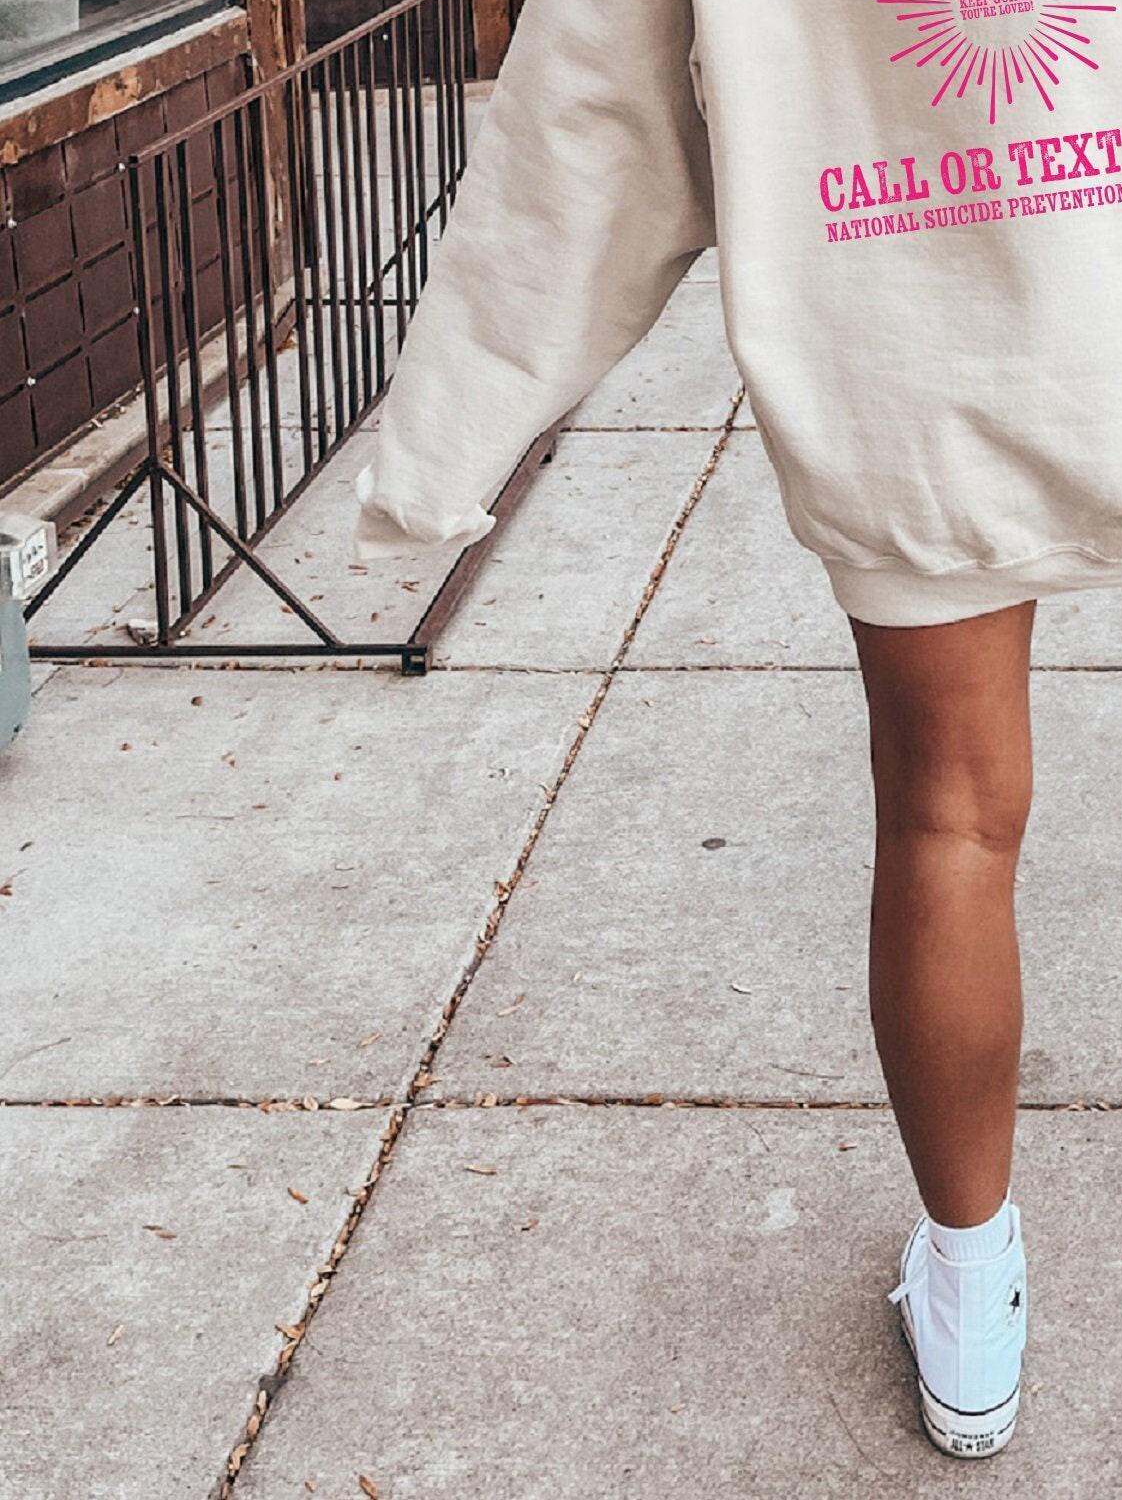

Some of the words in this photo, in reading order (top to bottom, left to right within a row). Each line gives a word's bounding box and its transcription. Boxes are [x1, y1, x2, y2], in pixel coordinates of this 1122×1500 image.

[960, 6, 997, 21] YOU'RE
[999, 0, 1034, 16] LOVED!
[819, 157, 930, 212] CALL
[940, 148, 1002, 195] OR
[1008, 129, 1122, 186] TEXT
[826, 212, 921, 242] NATIONAL
[924, 199, 1004, 230] SUICIDE
